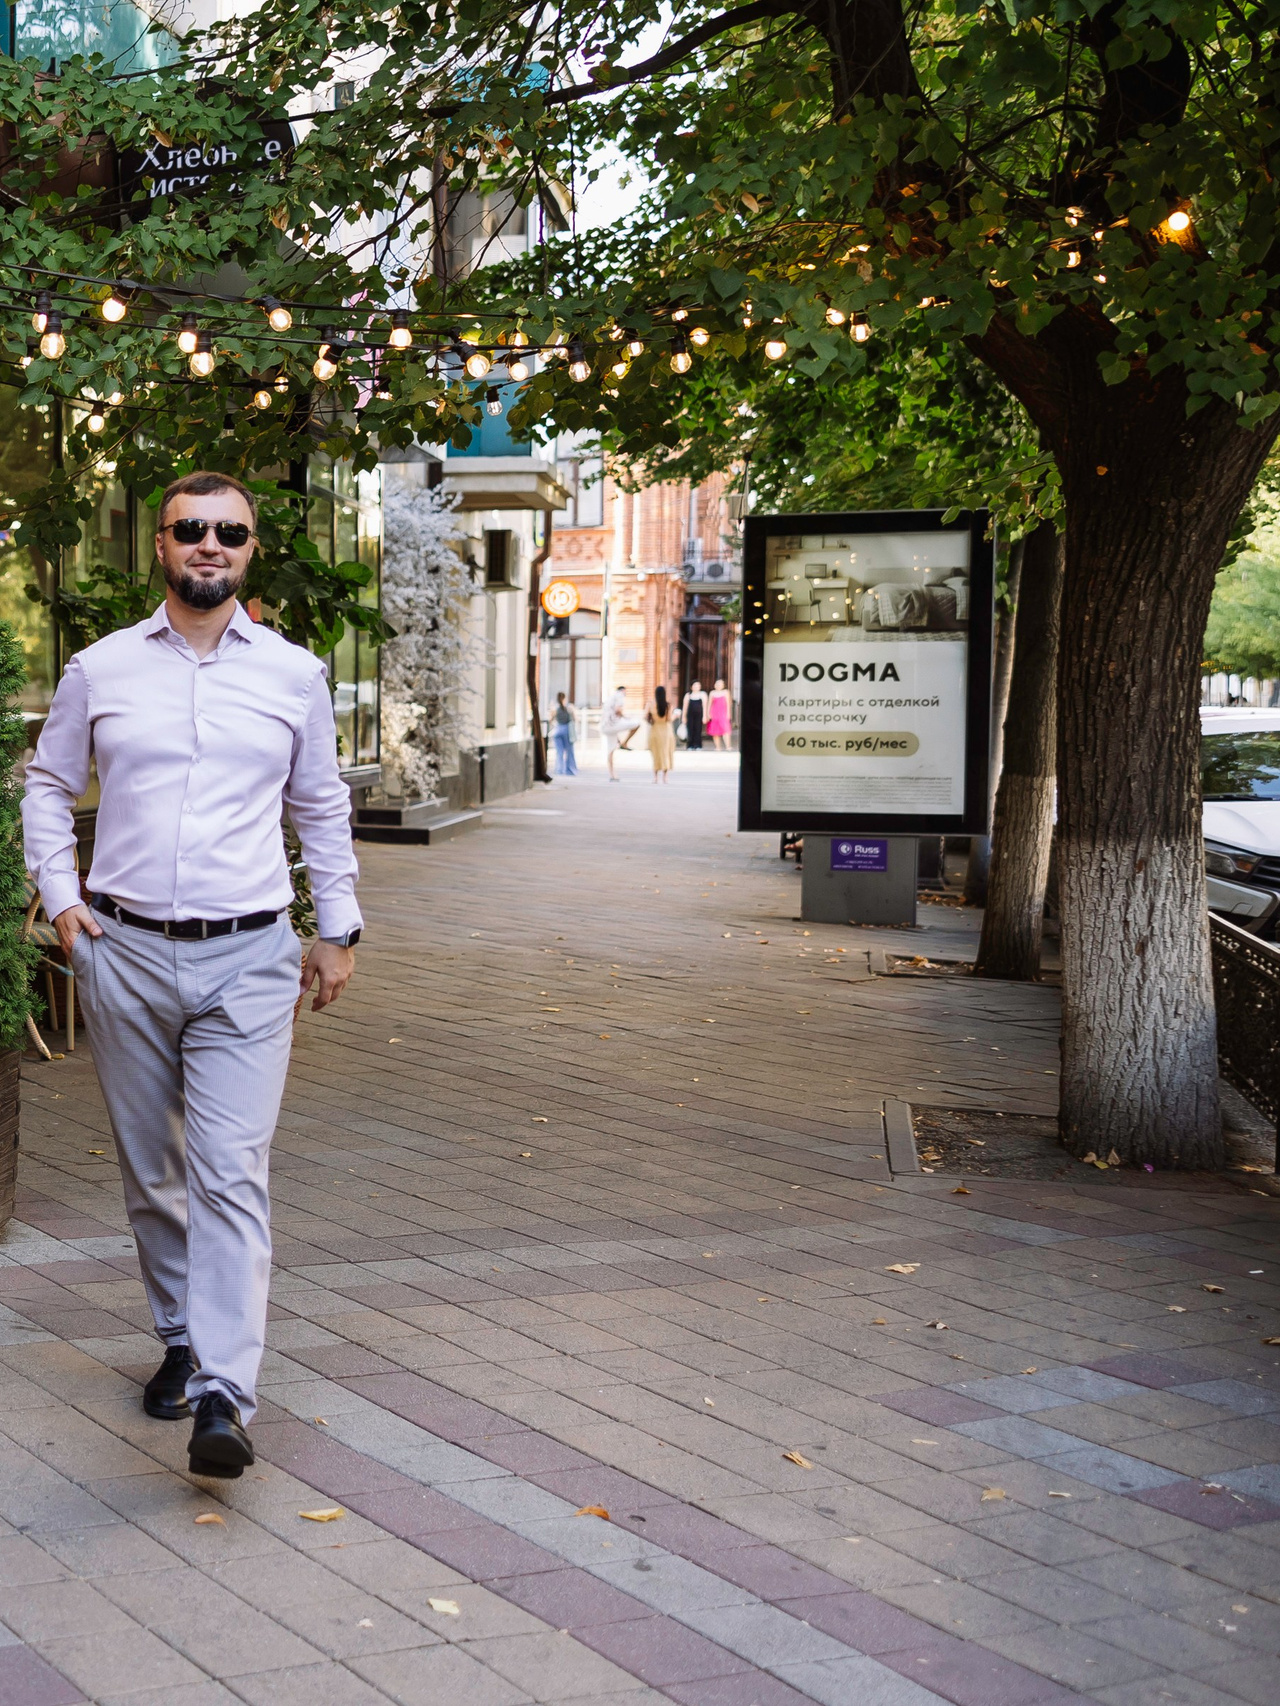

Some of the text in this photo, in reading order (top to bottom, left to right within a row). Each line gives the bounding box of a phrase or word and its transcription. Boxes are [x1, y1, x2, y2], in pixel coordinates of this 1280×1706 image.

[135, 140, 282, 173] Хлебне
[779, 662, 901, 683] DOGMA
[778, 695, 940, 710] Квартиры с отделкой
[777, 713, 868, 725] в рассрочку
[786, 736, 908, 751] 40 тыс. руб/мес
[854, 844, 880, 854] Russ
